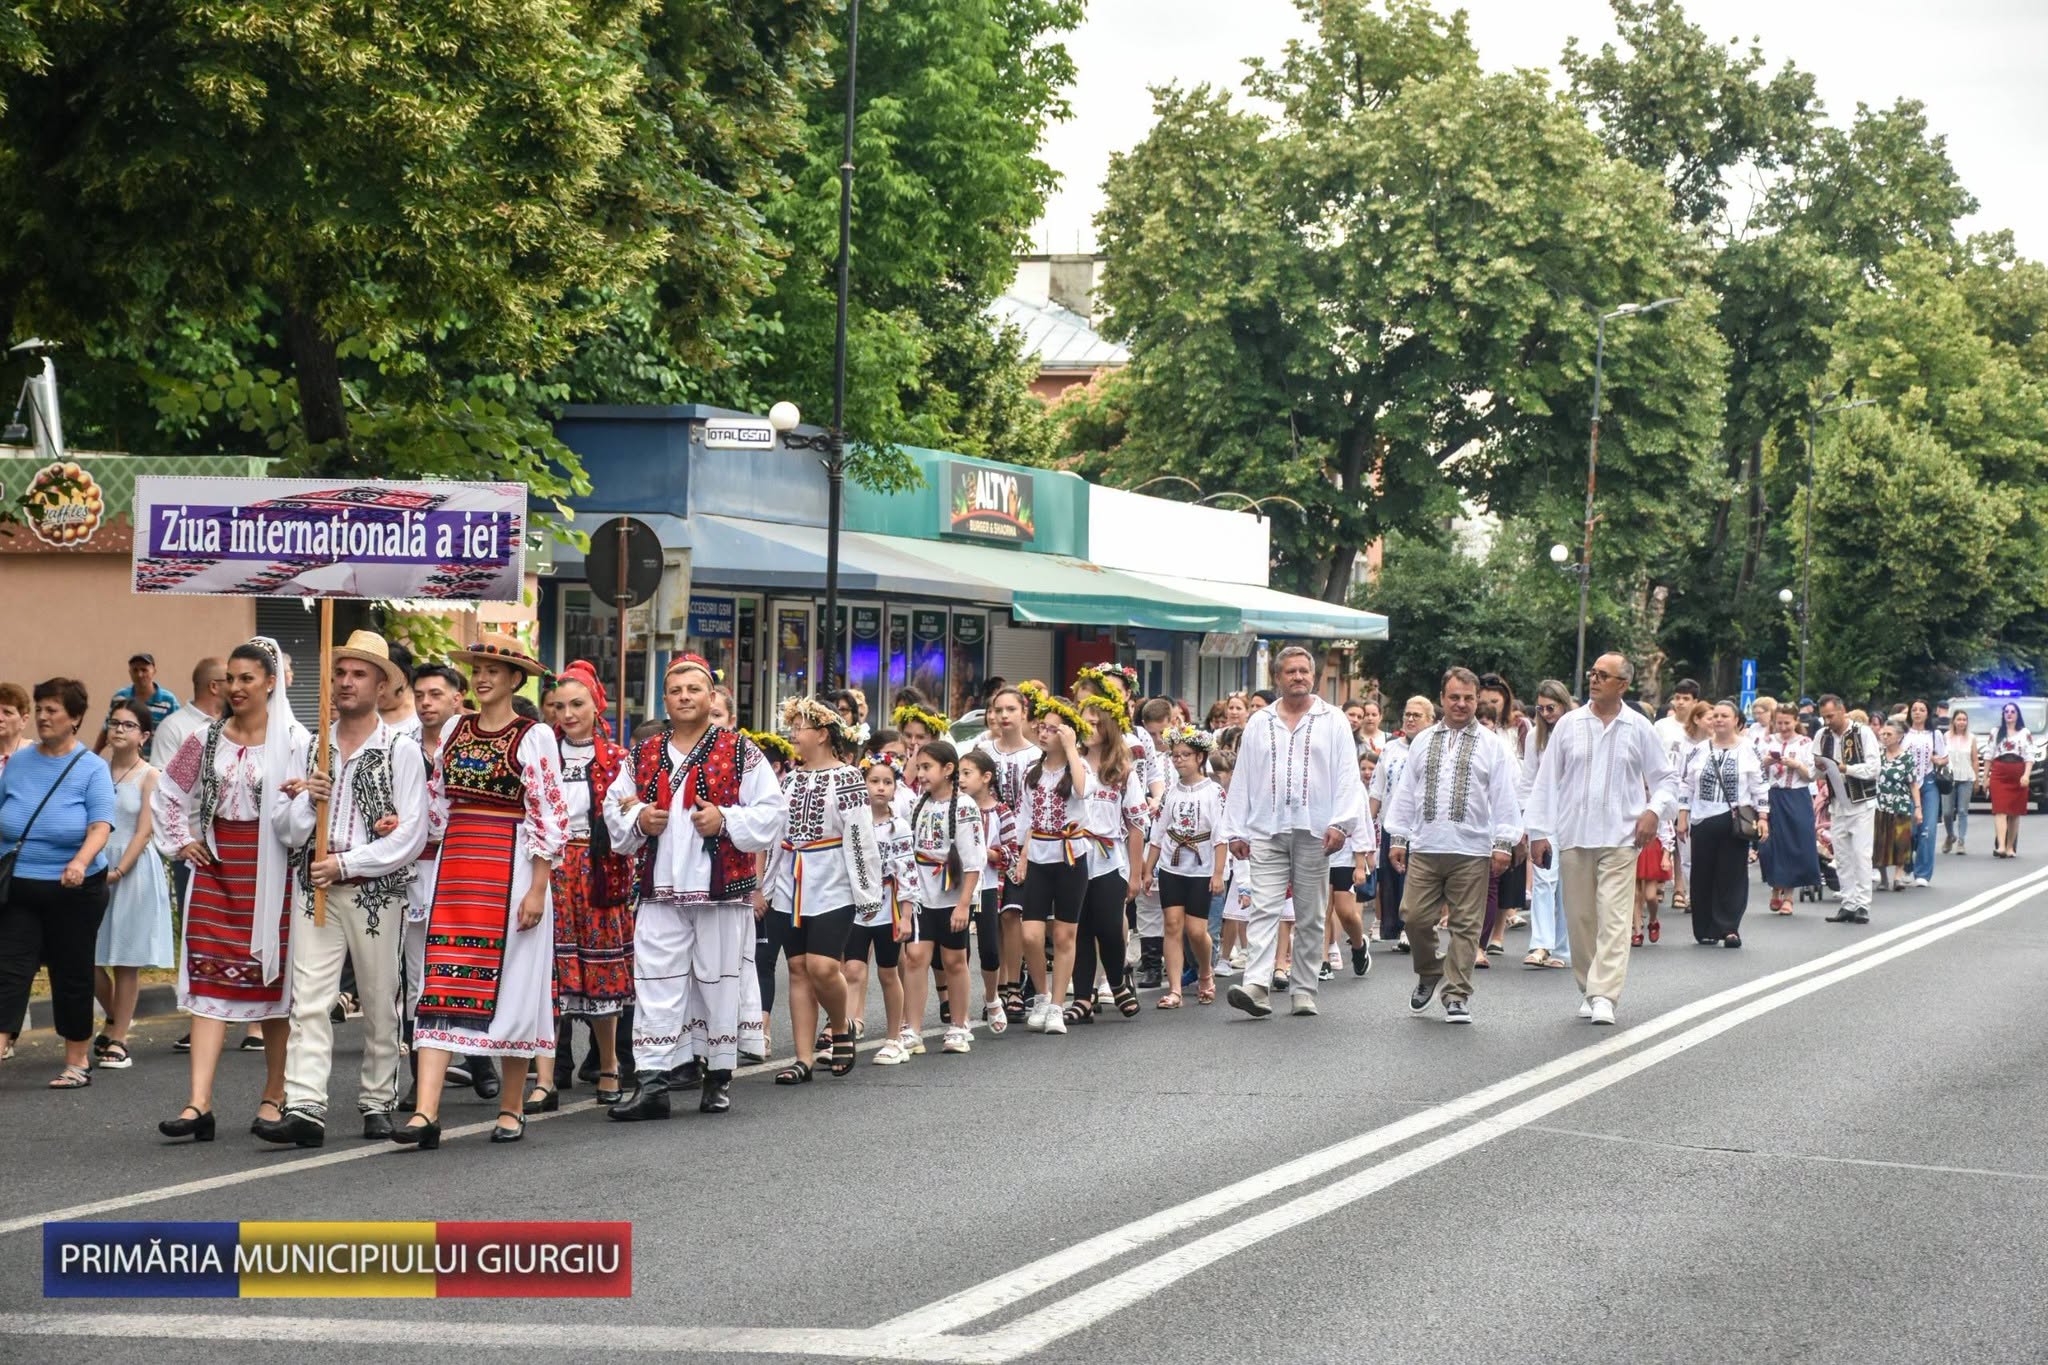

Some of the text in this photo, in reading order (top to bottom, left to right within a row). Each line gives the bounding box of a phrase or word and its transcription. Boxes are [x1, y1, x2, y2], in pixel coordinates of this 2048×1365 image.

[706, 427, 769, 441] TOTAL GSM
[975, 470, 1011, 513] ALTY
[160, 505, 222, 553] Ziua
[435, 523, 453, 559] a
[461, 511, 499, 560] iei
[969, 519, 989, 532] BURGER
[689, 601, 717, 615] CCESORII
